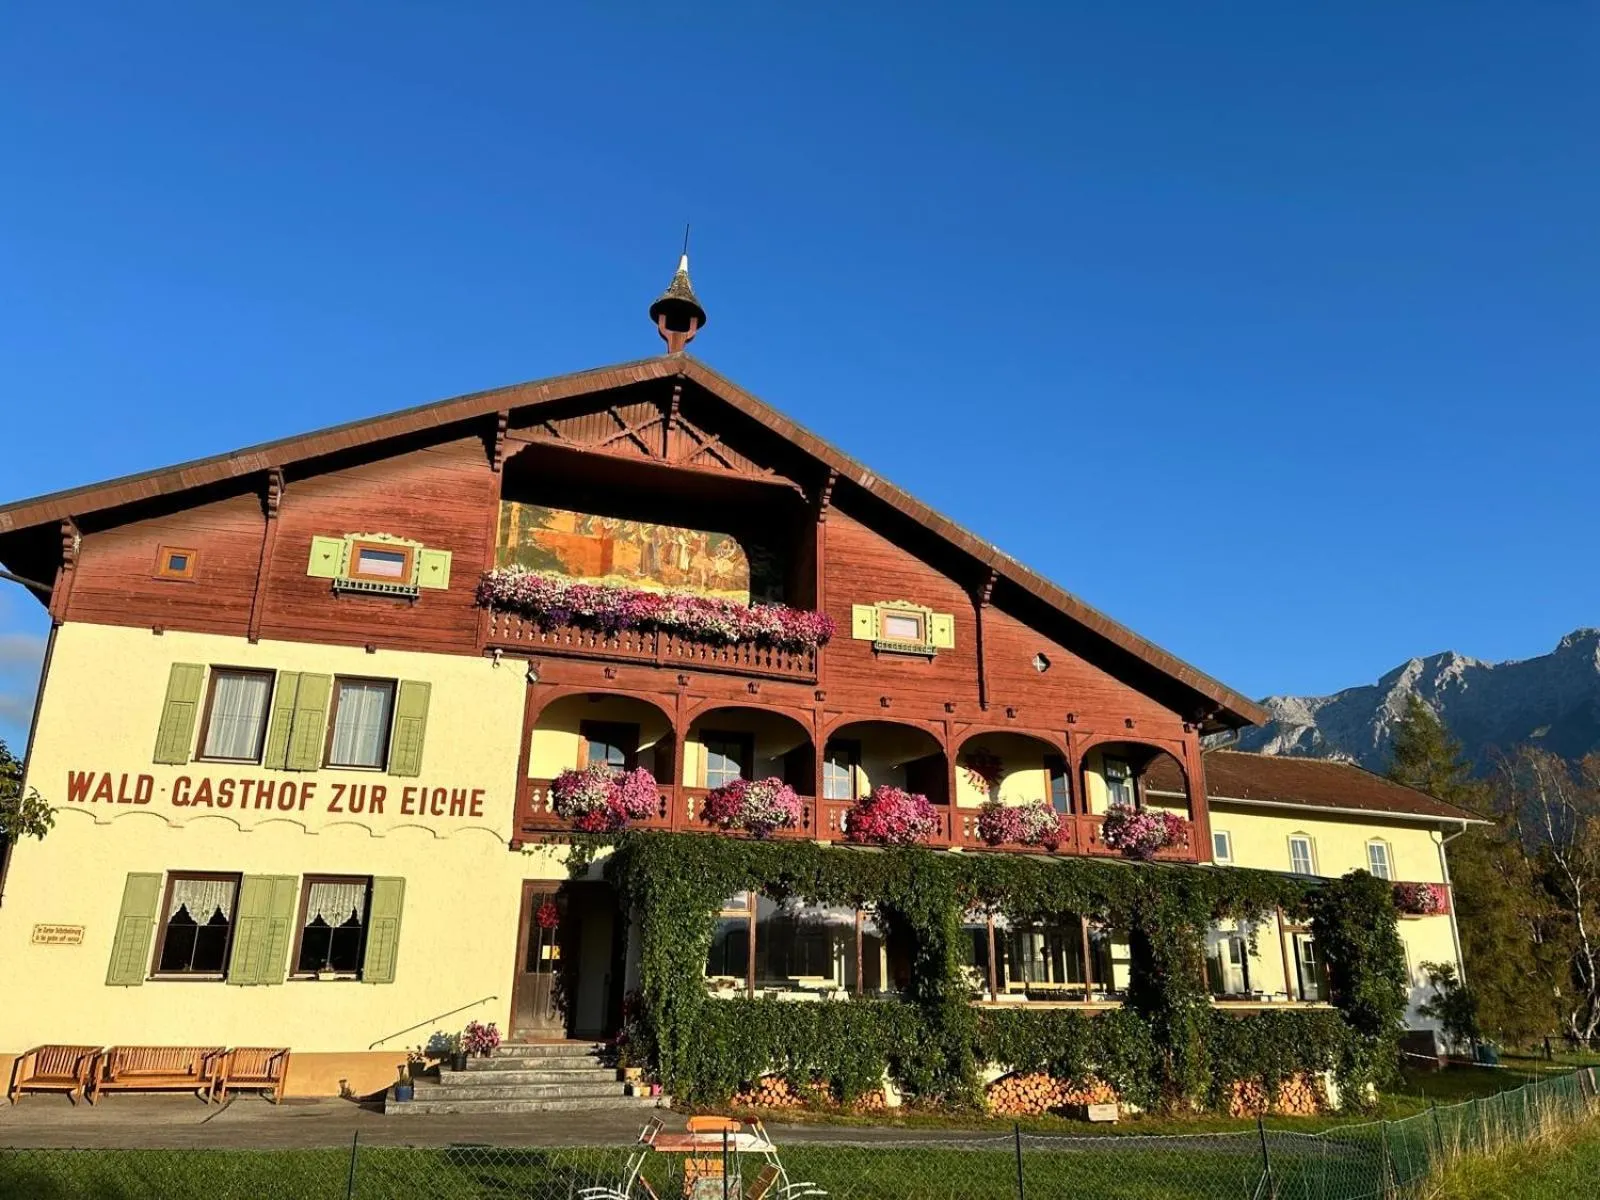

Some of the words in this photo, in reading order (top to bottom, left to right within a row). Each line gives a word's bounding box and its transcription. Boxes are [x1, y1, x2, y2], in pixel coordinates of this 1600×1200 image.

[67, 771, 154, 805] WALD
[171, 777, 316, 811] GASTHOF
[327, 784, 387, 814] ZUR
[401, 786, 485, 817] EICHE
